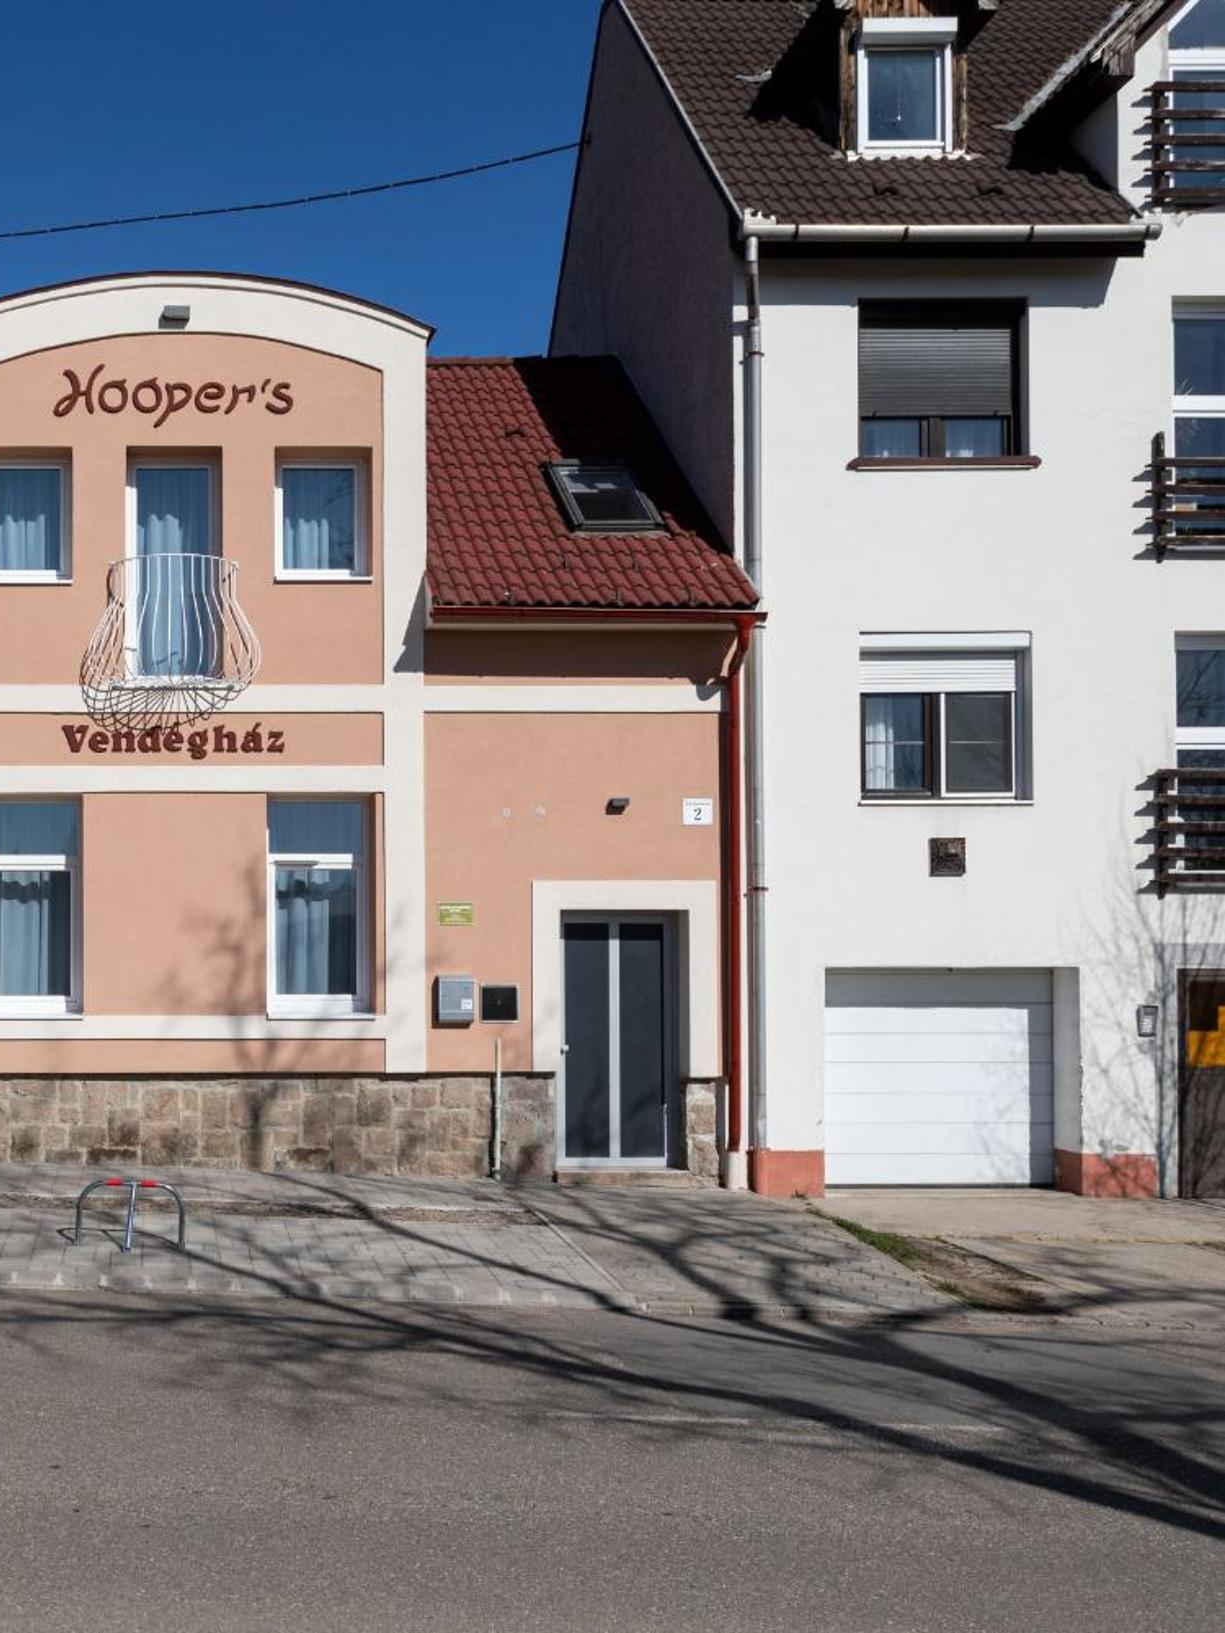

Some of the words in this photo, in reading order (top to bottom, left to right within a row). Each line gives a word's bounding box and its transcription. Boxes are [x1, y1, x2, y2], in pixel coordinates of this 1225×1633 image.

[53, 363, 294, 429] Hooper's
[61, 722, 286, 760] Vendégház
[693, 807, 702, 821] 2
